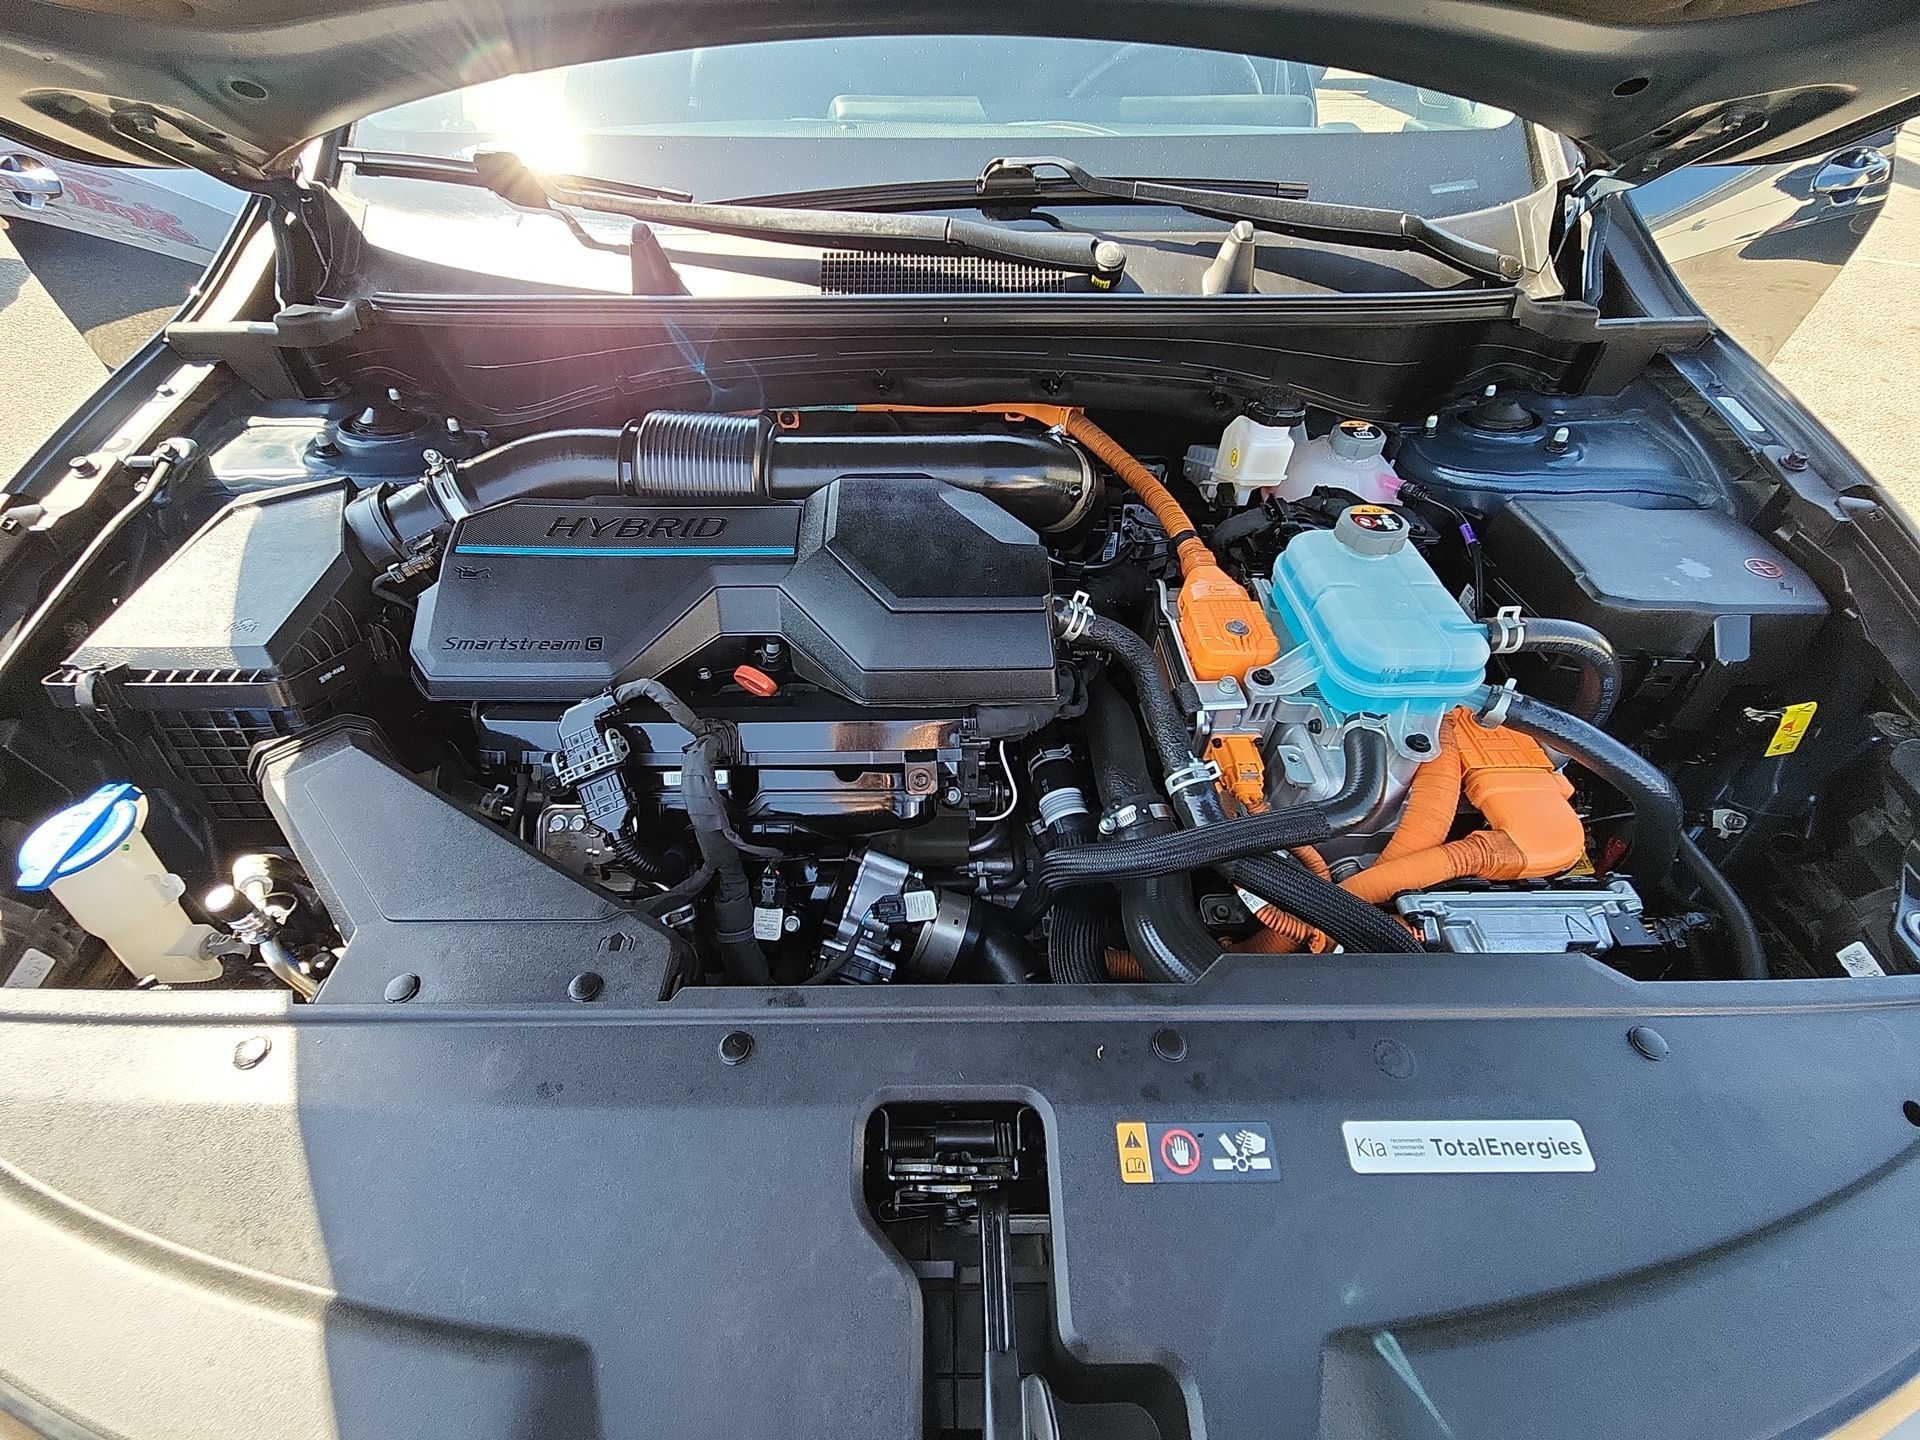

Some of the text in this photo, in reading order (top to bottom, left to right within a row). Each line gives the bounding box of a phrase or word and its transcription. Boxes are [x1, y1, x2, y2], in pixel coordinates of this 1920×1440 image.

[545, 516, 728, 538] HYBRID
[442, 636, 582, 650] Smartstream
[1381, 667, 1406, 675] MAX
[1354, 1137, 1387, 1157] Kia
[1430, 1136, 1583, 1159] TotalEnergies
